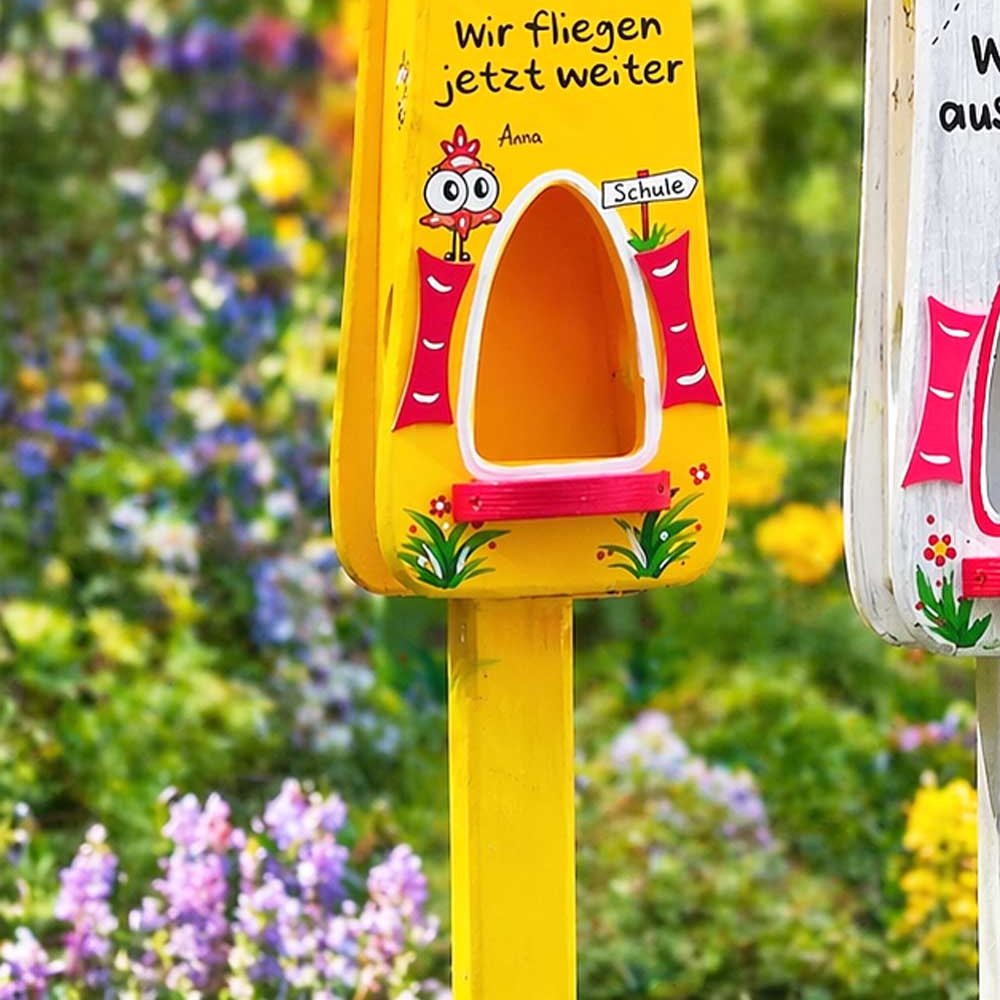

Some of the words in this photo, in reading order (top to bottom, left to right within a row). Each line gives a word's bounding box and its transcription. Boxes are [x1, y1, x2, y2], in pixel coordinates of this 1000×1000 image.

[455, 16, 514, 48] Wir
[524, 10, 662, 54] fliegen
[434, 59, 545, 107] jetzt
[557, 54, 683, 88] weiter
[498, 124, 543, 147] Anna
[614, 178, 685, 202] Schule
